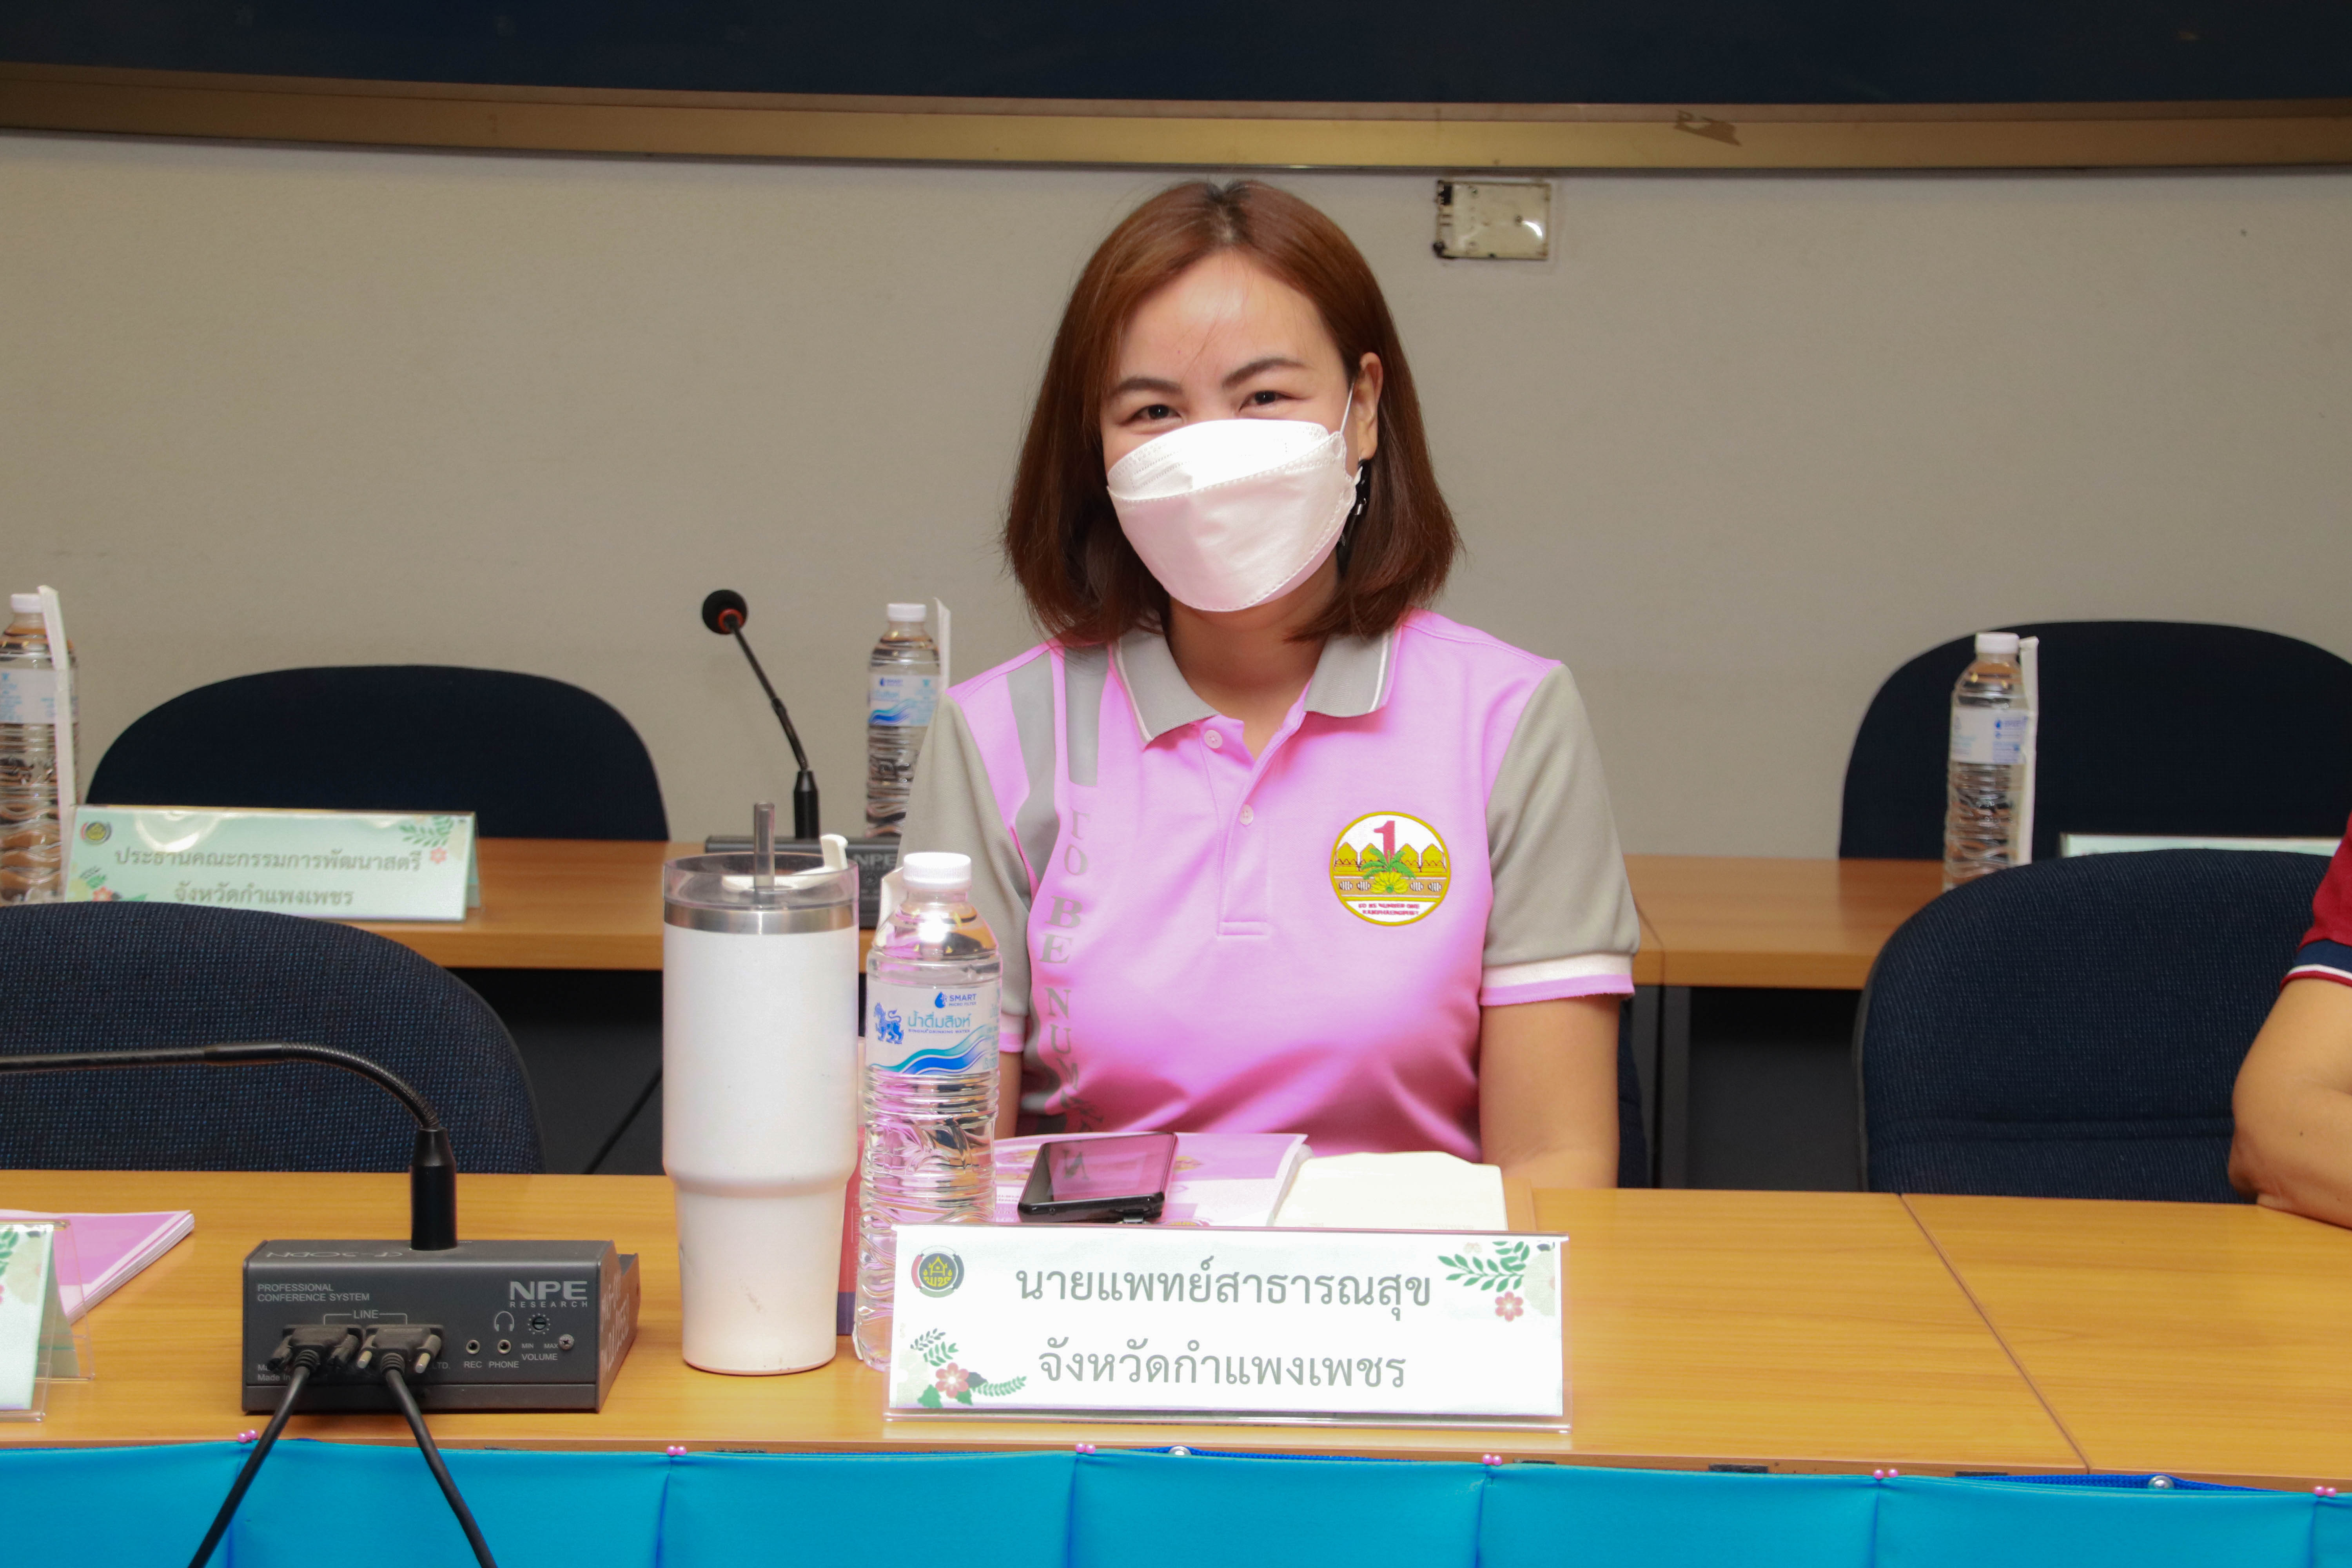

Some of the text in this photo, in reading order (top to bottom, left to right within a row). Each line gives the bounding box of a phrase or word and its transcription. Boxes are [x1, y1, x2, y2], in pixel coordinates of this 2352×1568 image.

[115, 848, 422, 872] ประธานคณะกรรมการพัฒนาสตรี
[173, 881, 354, 906] จังหวัดกำแพงเพชร
[1039, 895, 1083, 964] BE
[907, 1010, 972, 1028] น้ำดื่มสิงห์
[257, 1283, 334, 1292] PROFESSIONAL
[257, 1293, 370, 1302] CONFERENCE SYSTEM
[510, 1281, 588, 1300] NPE
[1015, 1256, 1431, 1321] นายแพทย์สาธารณสุข
[354, 1309, 379, 1319] LINE
[1039, 1337, 1406, 1387] จังหวัดกำแพงเพชร
